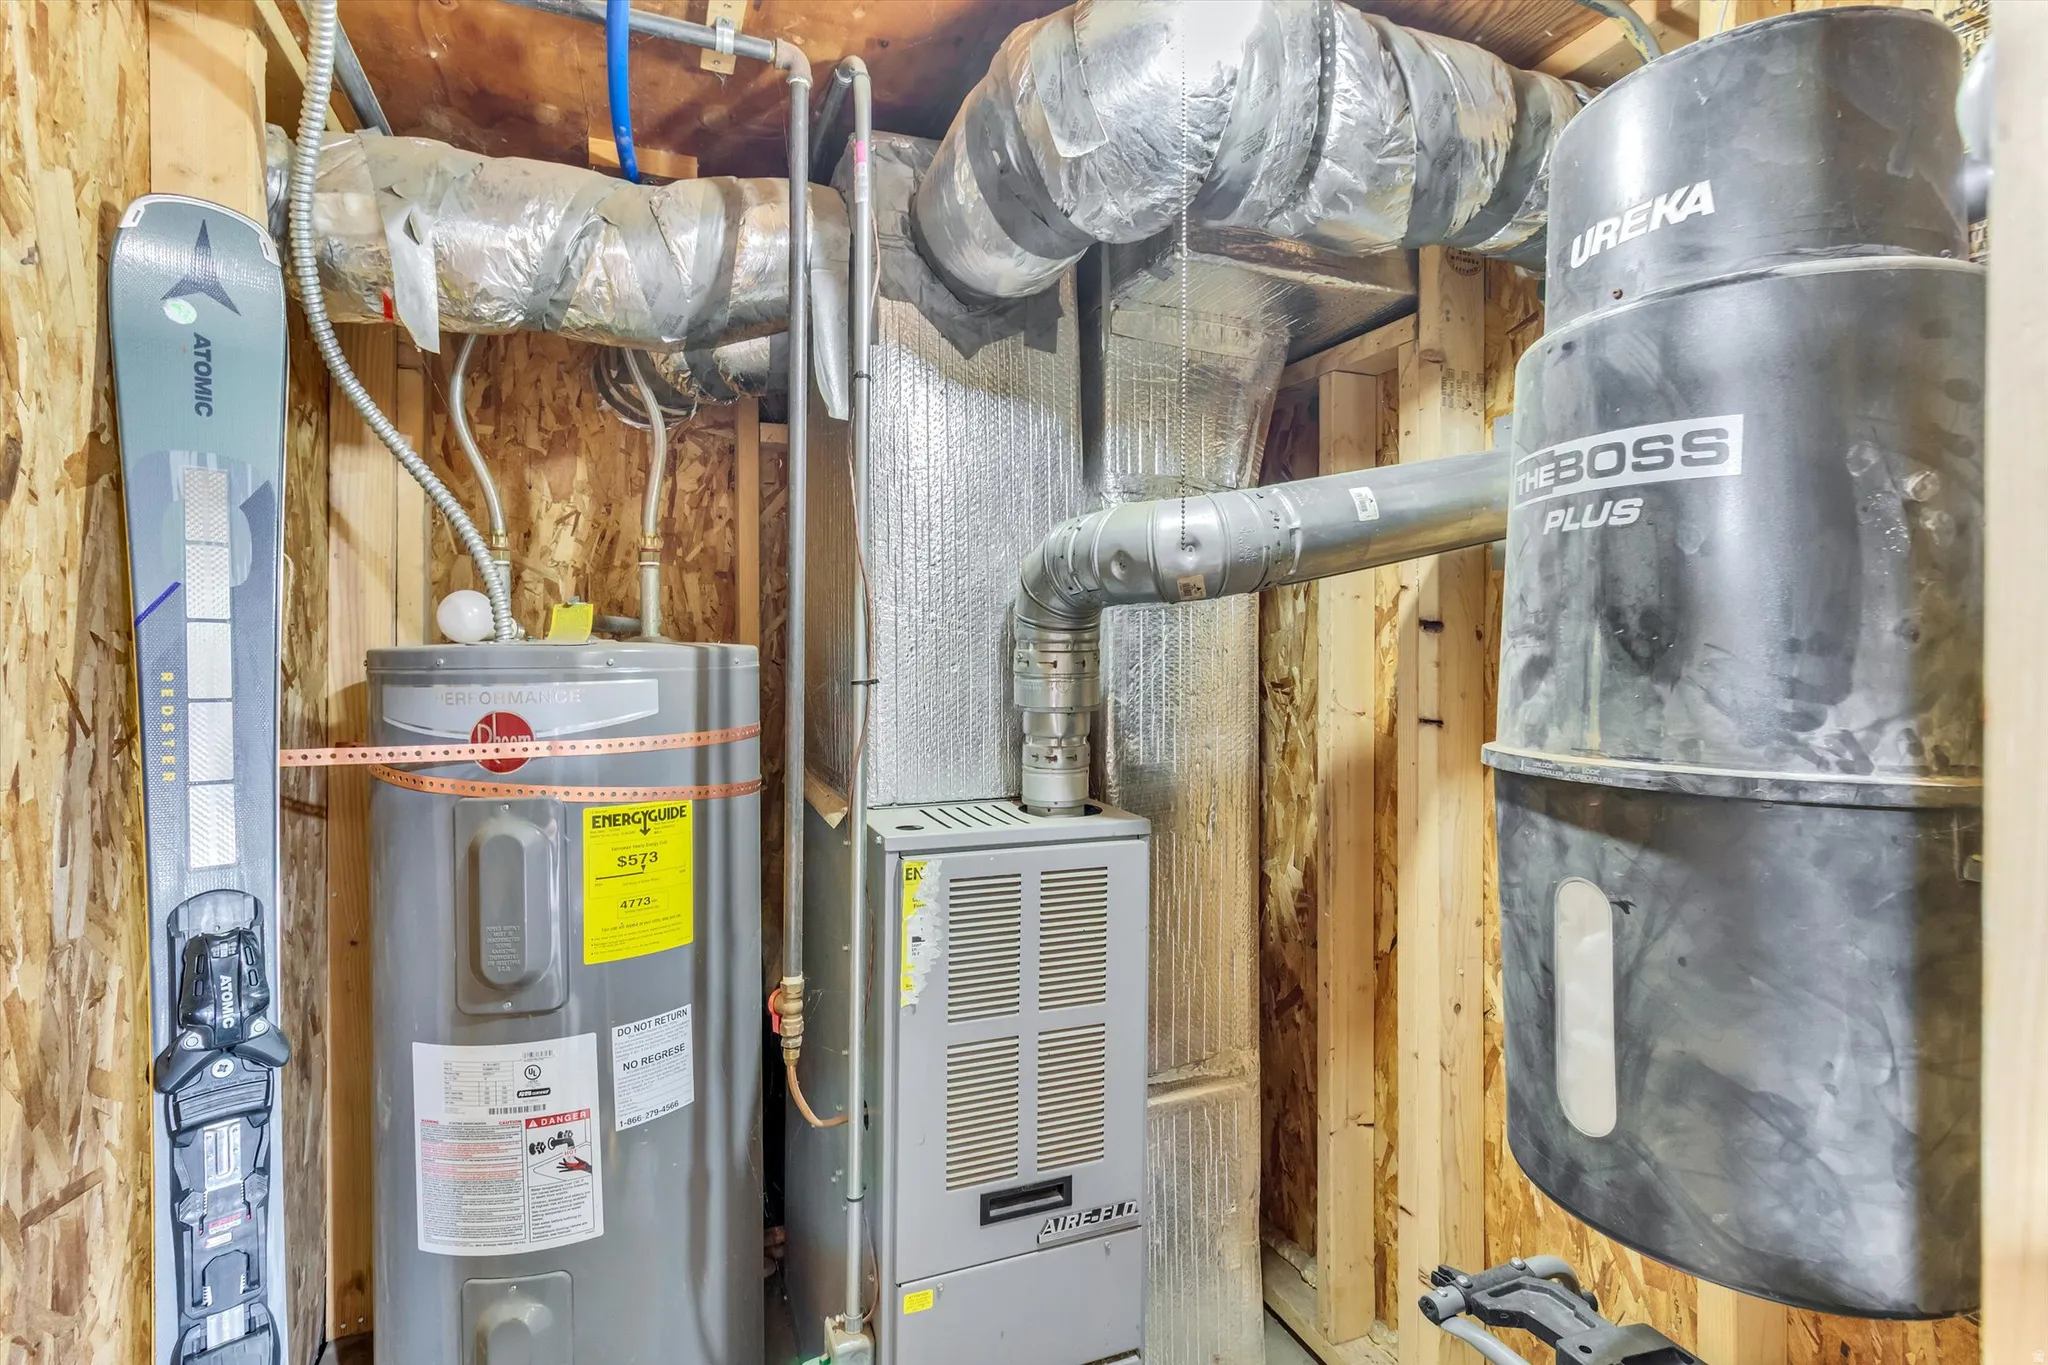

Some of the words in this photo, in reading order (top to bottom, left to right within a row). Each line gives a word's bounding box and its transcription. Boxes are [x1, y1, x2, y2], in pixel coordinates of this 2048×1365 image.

[1570, 180, 1715, 269] UREKA
[193, 331, 213, 418] ATOMIC
[1516, 463, 1555, 496] THE
[1553, 428, 1730, 485] BOSS
[1542, 498, 1644, 535] PLUS
[161, 671, 176, 782] REDSTER
[617, 851, 658, 868] $573
[620, 896, 651, 909] 4773
[220, 975, 235, 1029] ATOMIC
[617, 1026, 631, 1037] DO
[634, 1020, 652, 1033] NOT
[654, 1008, 688, 1026] RETURN
[623, 1060, 638, 1071] NO
[641, 1042, 686, 1066] REGRESE
[541, 1111, 586, 1126] DANGER
